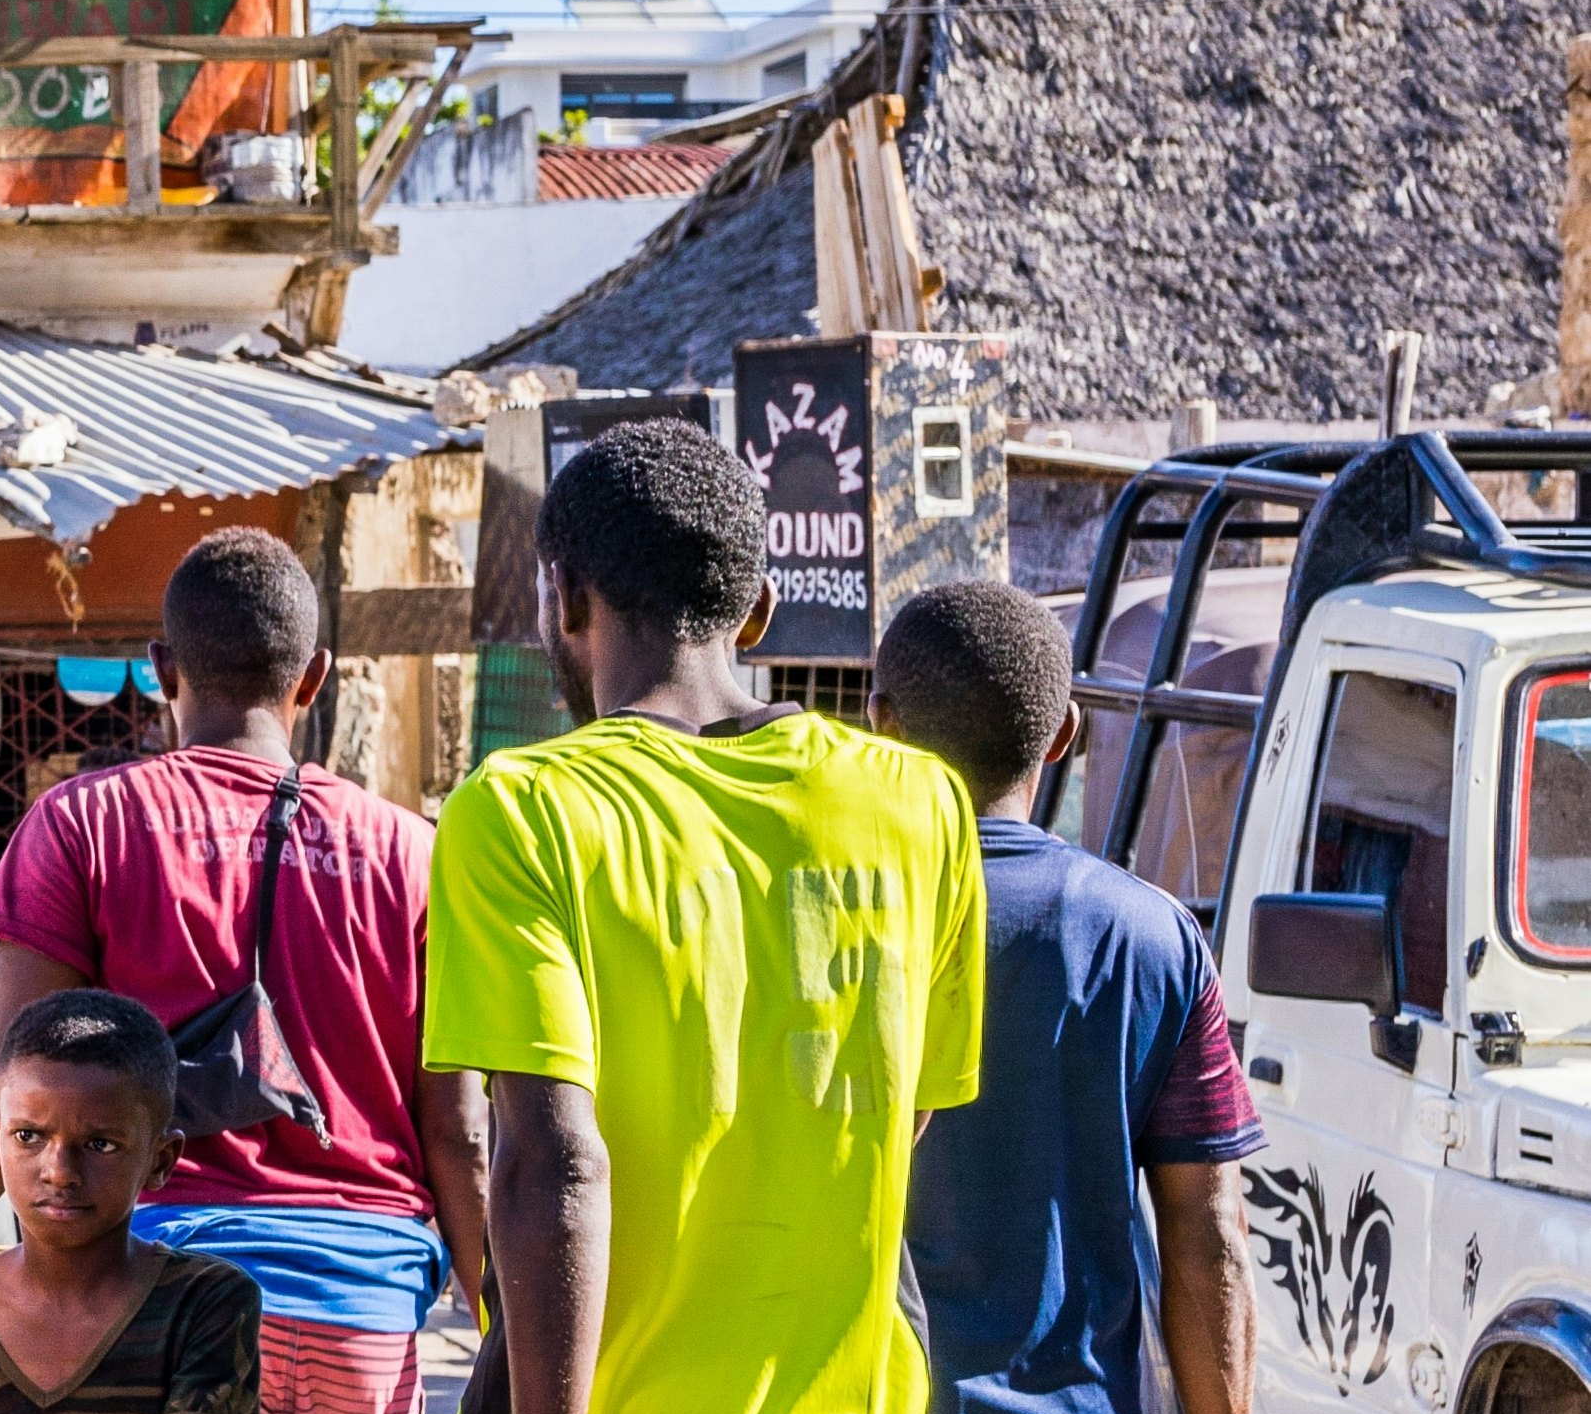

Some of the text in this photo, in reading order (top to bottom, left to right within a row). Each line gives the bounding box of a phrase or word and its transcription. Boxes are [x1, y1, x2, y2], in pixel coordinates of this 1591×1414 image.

[951, 345, 975, 395] 4
[744, 383, 864, 494] KAZAM
[768, 511, 865, 559] OUND
[768, 566, 867, 611] 21935385
